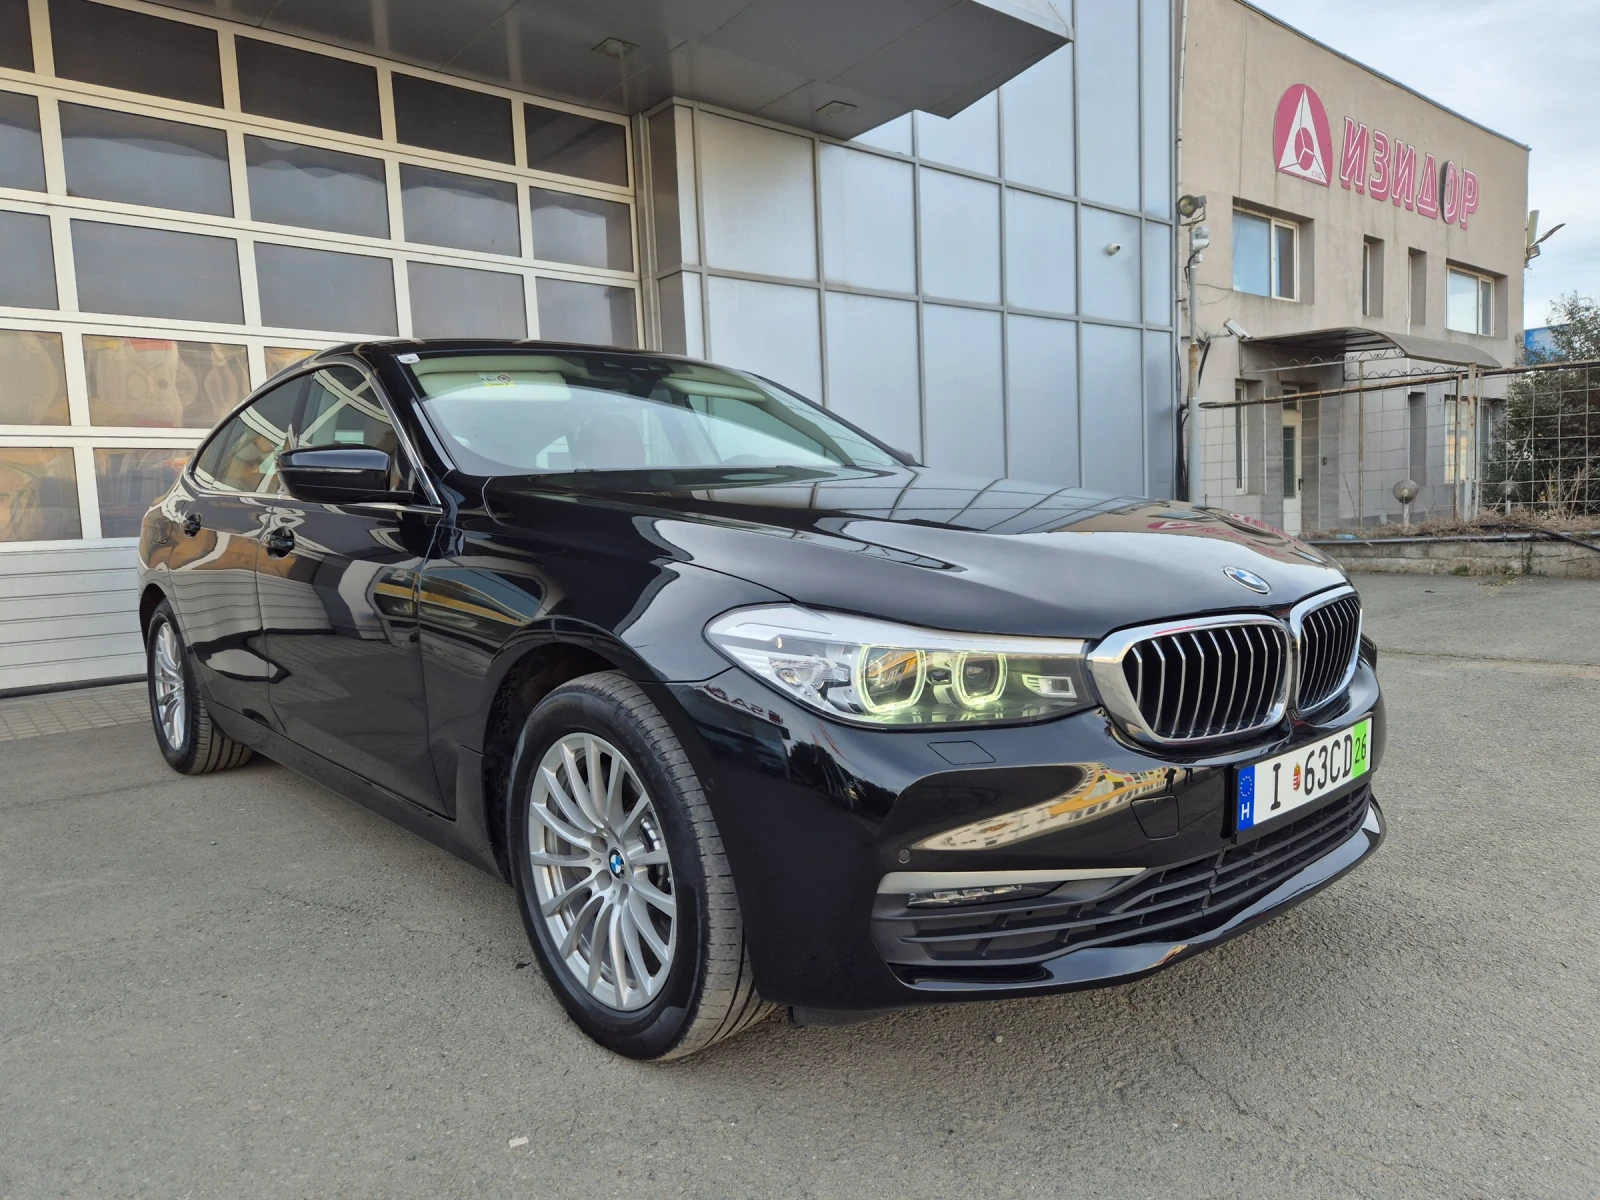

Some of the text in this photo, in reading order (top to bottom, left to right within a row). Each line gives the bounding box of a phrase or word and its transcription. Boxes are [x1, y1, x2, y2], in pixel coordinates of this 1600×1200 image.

[1339, 115, 1479, 230] ИЗИДОР
[1304, 734, 1353, 796] 63CD
[1354, 734, 1367, 764] 26
[1241, 801, 1250, 821] H
